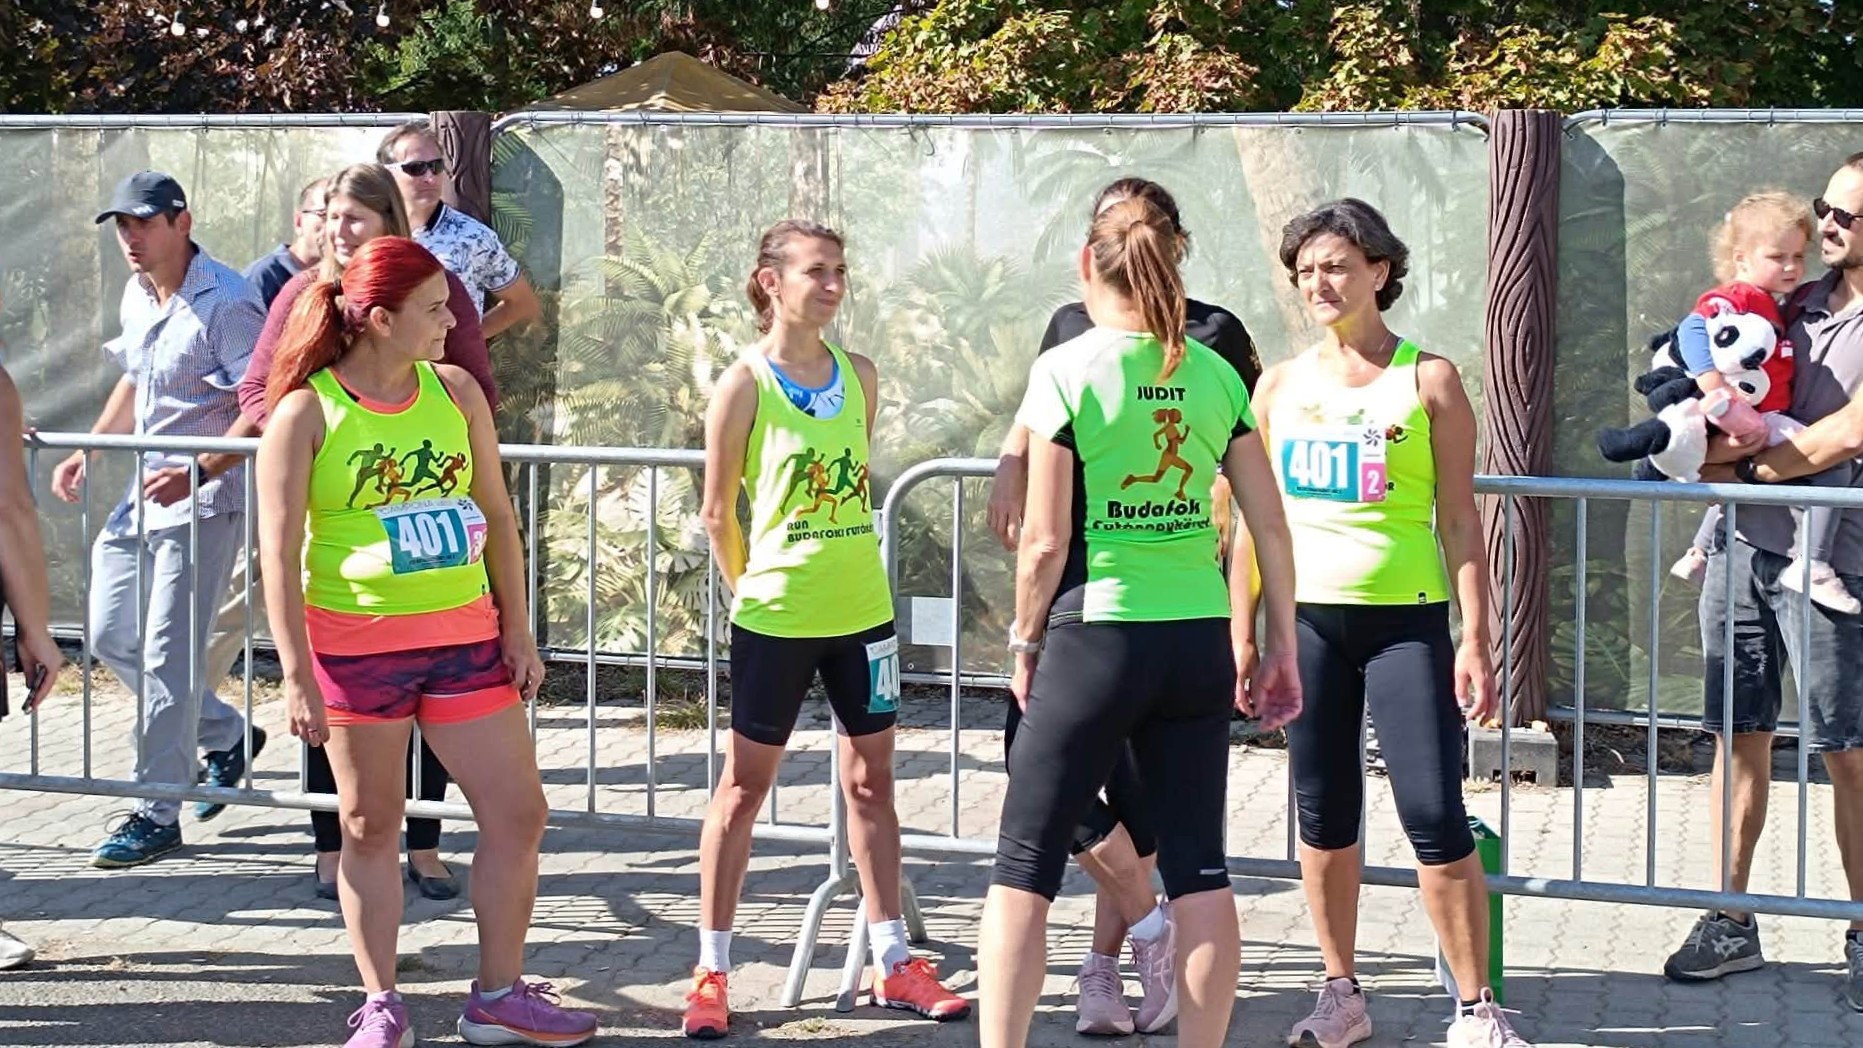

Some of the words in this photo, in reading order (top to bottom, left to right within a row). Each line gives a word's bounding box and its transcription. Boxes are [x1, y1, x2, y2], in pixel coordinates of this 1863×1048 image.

[1137, 385, 1186, 401] JUDIT
[1288, 440, 1348, 489] 401
[1367, 470, 1380, 495] 2
[1107, 499, 1200, 519] Budafok
[397, 511, 459, 558] 401
[787, 520, 809, 531] RUN
[787, 529, 845, 542] BUDAFOKI
